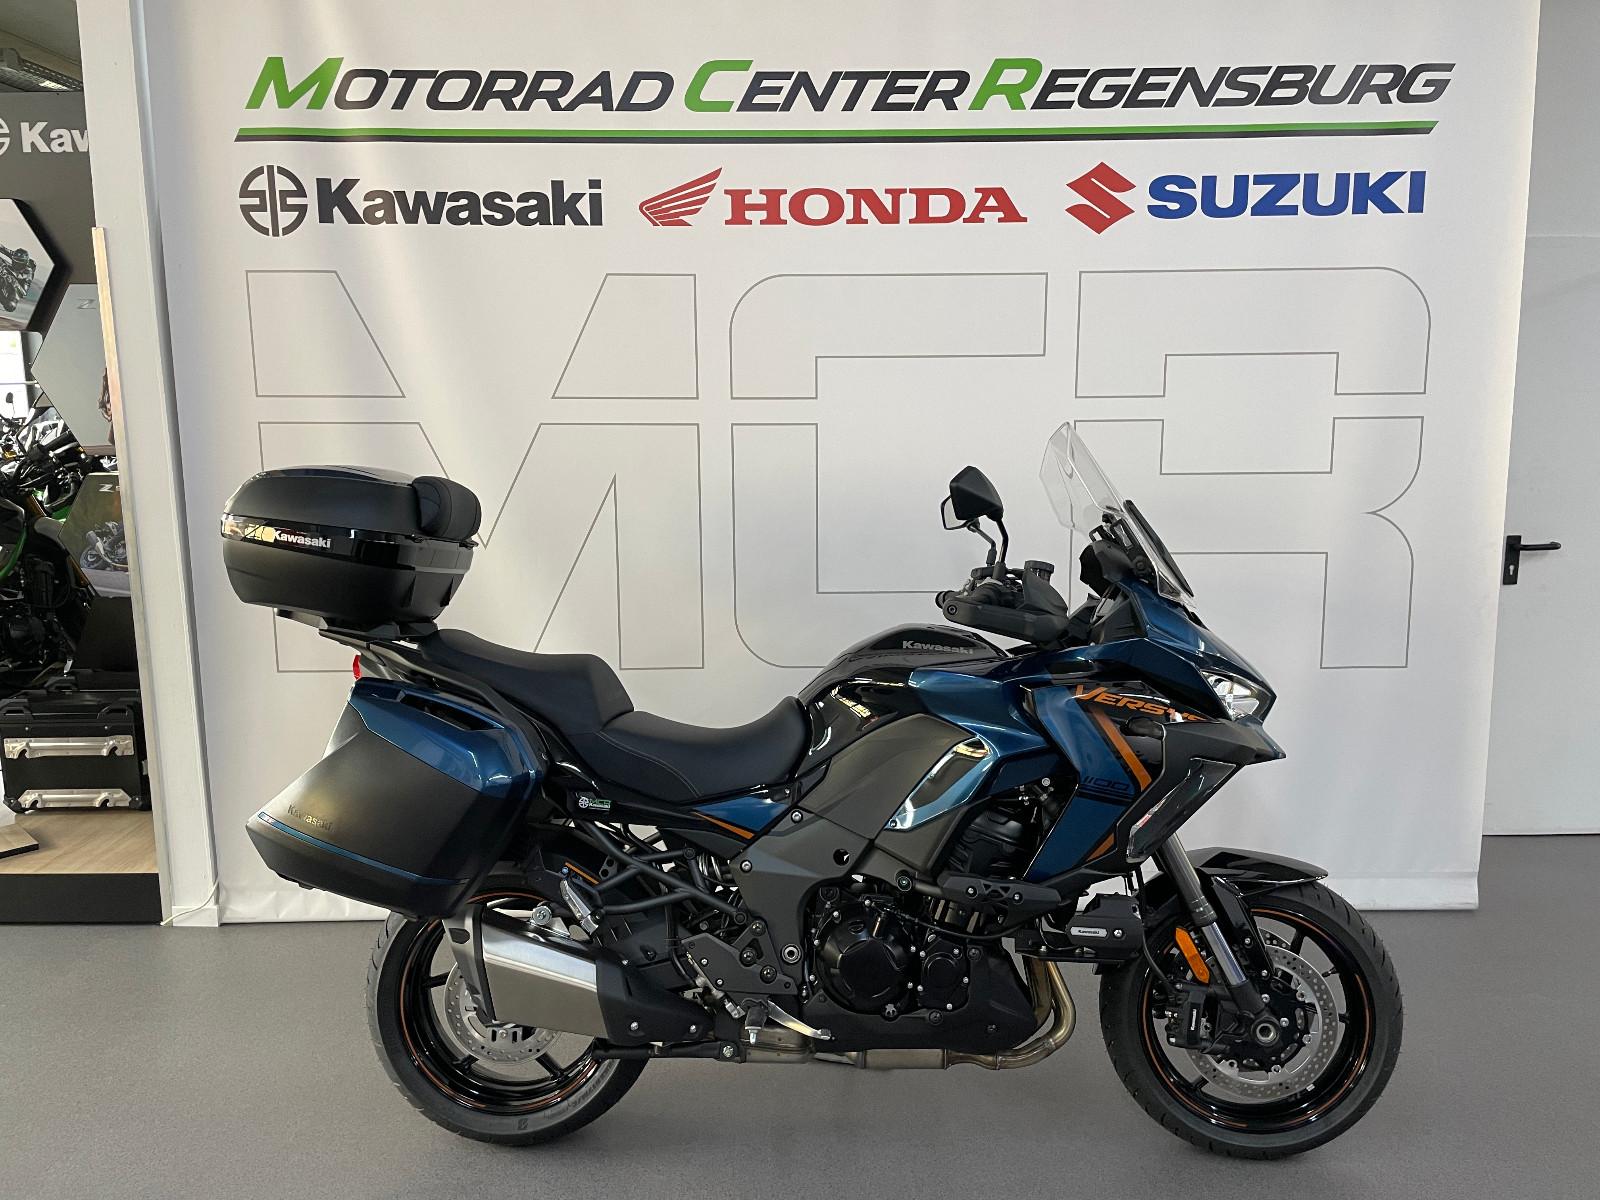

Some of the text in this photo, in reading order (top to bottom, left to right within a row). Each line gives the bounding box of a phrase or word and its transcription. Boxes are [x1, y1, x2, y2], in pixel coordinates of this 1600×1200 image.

[245, 57, 1457, 112] MOTORRAD CENTER REGENSBURG
[315, 178, 603, 227] Kawasaki
[723, 186, 1028, 226] HONDA
[1147, 170, 1427, 219] SUZUKI
[273, 530, 331, 549] Kawasaki
[902, 640, 974, 654] Kawasaki
